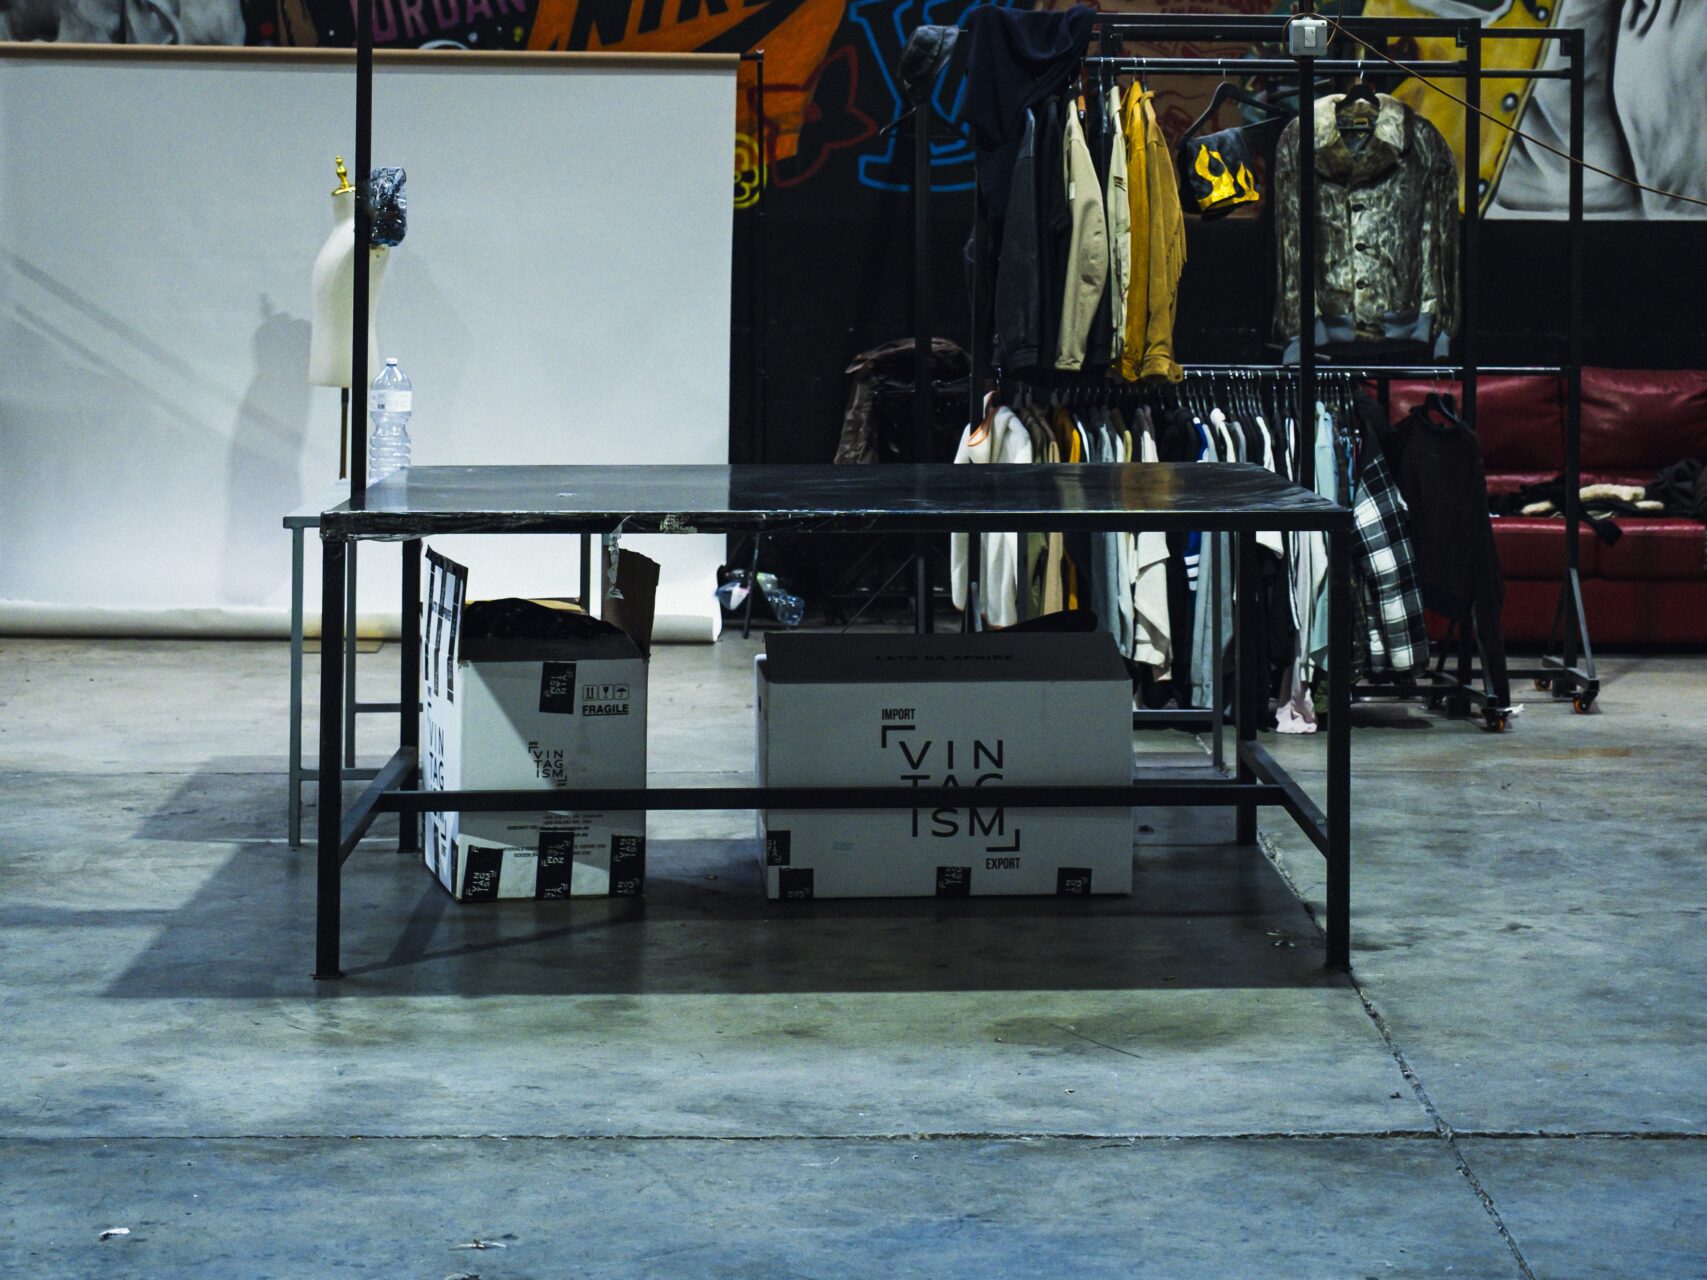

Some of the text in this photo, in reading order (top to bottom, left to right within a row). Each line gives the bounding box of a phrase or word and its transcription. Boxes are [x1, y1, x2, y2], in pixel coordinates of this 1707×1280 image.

[582, 704, 629, 714] FRAGILE
[881, 708, 915, 720] IMPORT
[535, 750, 564, 759] VIN
[900, 740, 1004, 770] VIN
[534, 759, 564, 769] TAG
[536, 769, 564, 779] ISM
[911, 807, 1005, 837] ISM
[986, 857, 1020, 870] EXPORT
